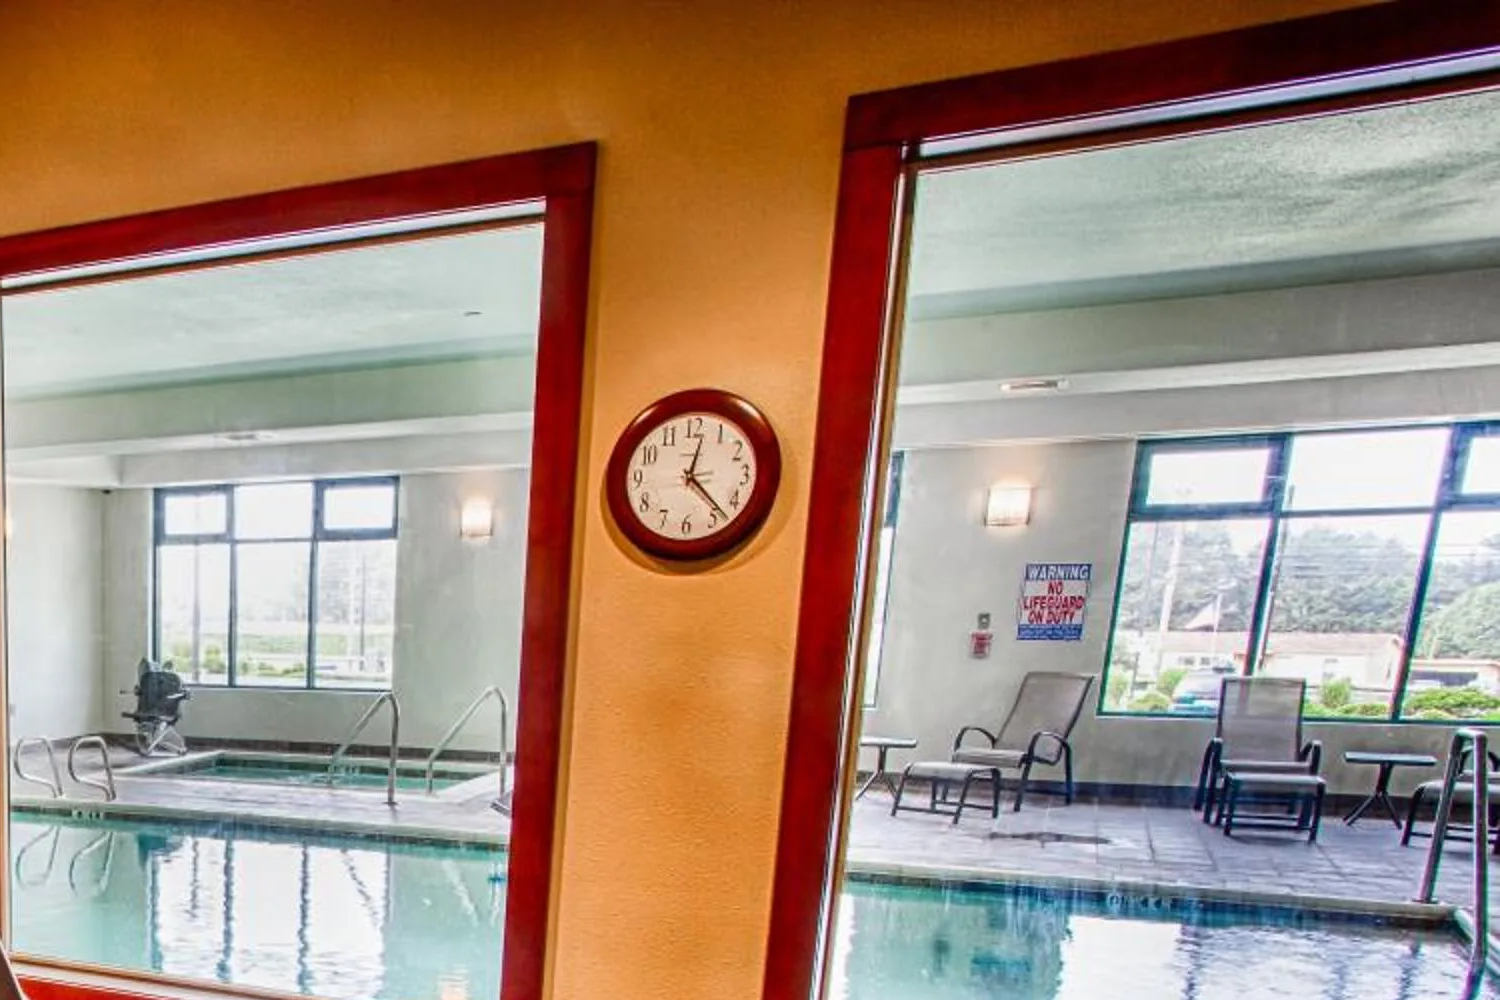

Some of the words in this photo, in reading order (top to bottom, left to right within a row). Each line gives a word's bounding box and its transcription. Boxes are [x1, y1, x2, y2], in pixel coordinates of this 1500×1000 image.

[661, 426, 676, 446] 11
[685, 418, 704, 438] 12
[717, 424, 724, 444] 1
[641, 445, 658, 465] 10
[732, 440, 743, 461] 2
[633, 470, 643, 490] 9
[739, 464, 750, 486] 3
[639, 492, 650, 512] 8
[729, 489, 739, 510] 4
[659, 509, 669, 529] 7
[681, 514, 691, 534] 6
[1028, 564, 1089, 580] WARNING
[1047, 580, 1063, 595] NO
[1023, 595, 1085, 609] LIFEGUARD
[1027, 610, 1043, 624] ON
[1045, 611, 1076, 624] DUTY
